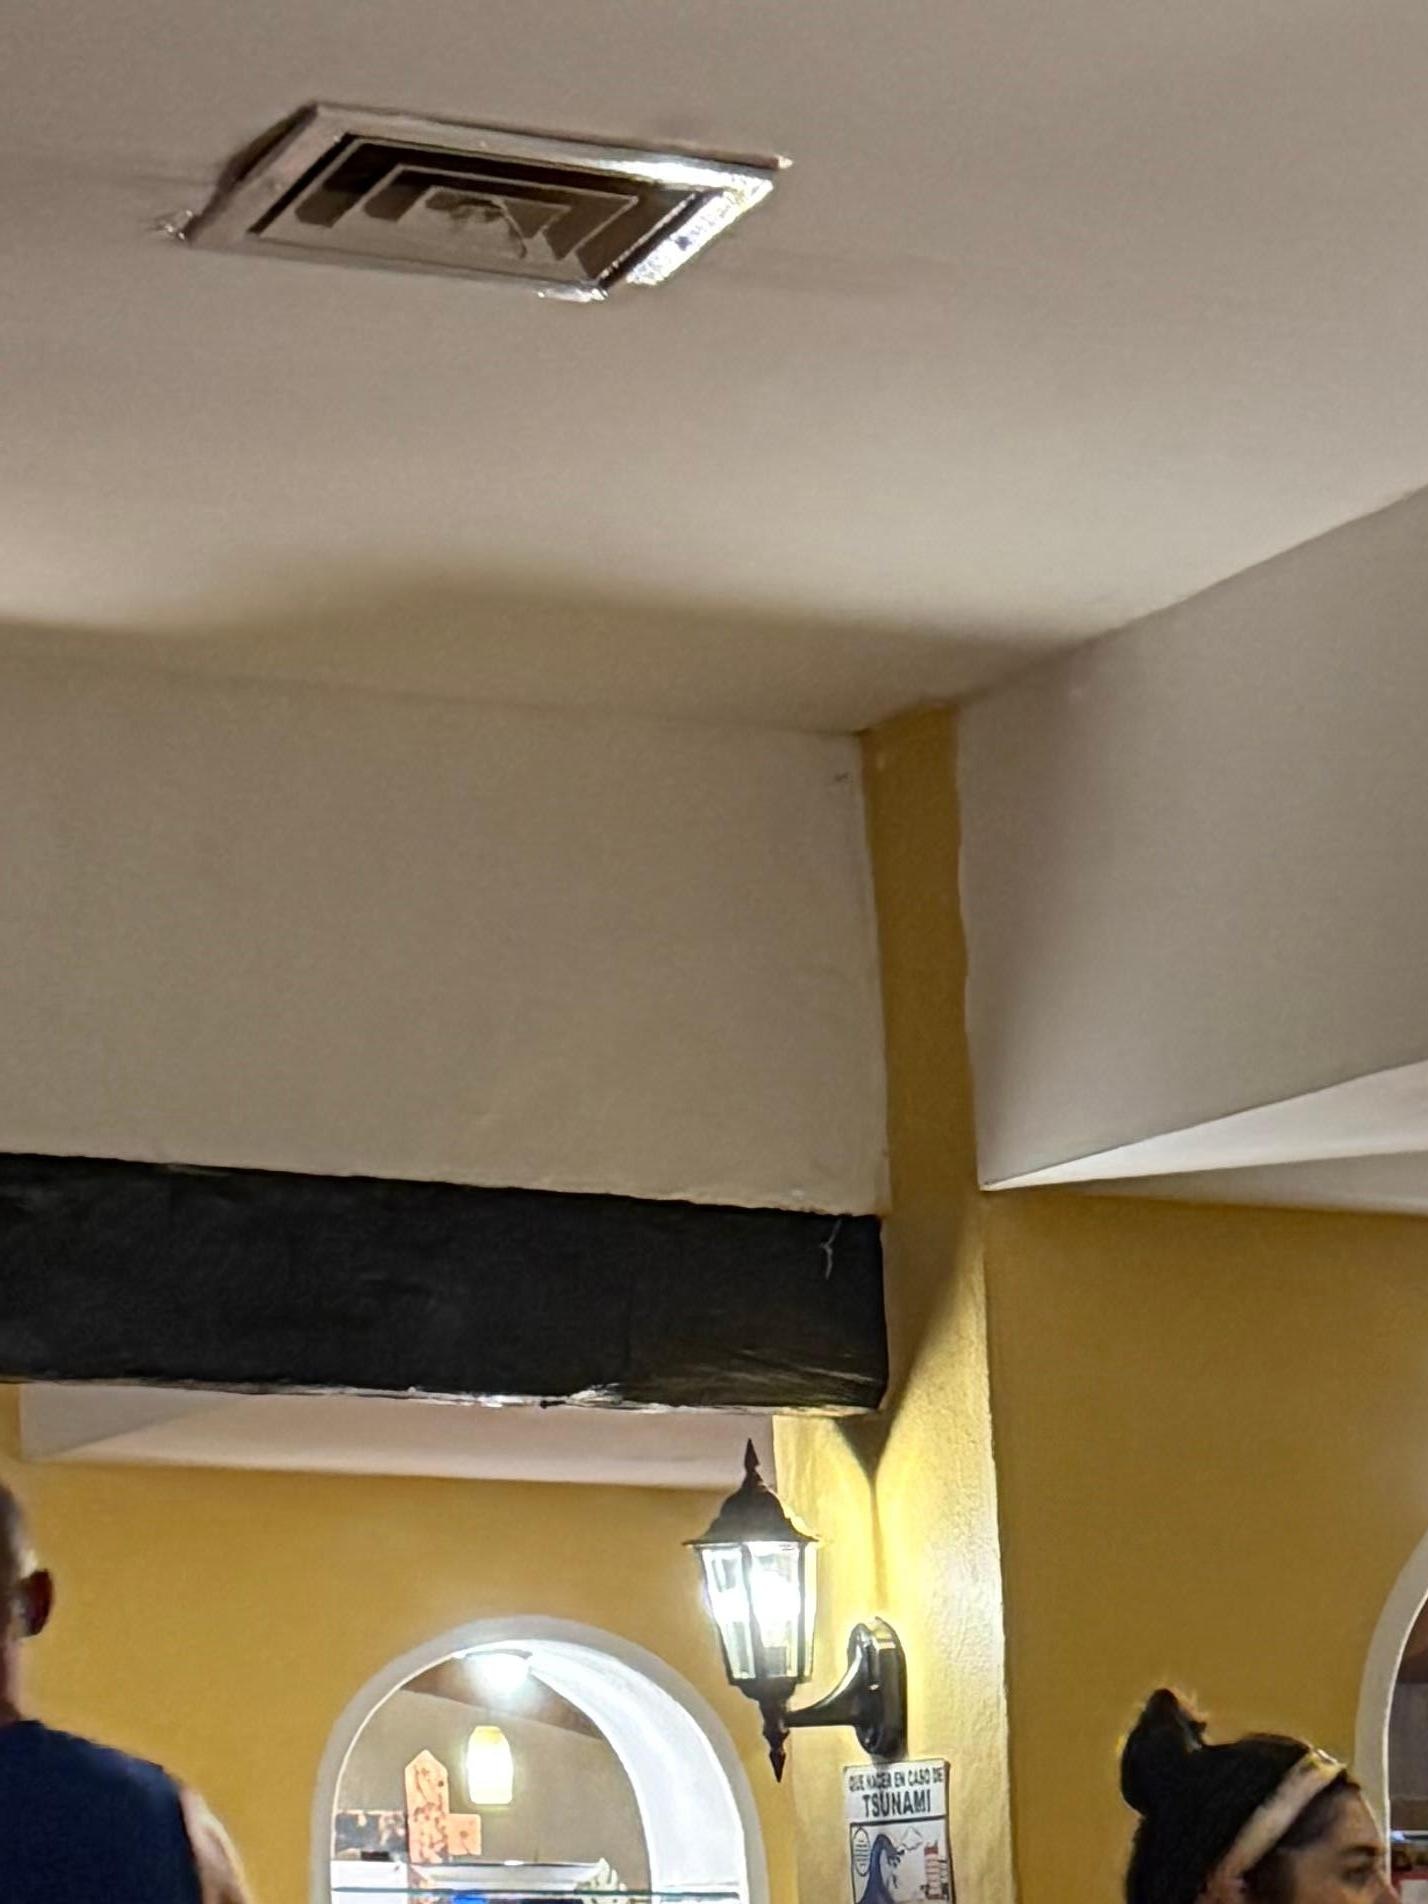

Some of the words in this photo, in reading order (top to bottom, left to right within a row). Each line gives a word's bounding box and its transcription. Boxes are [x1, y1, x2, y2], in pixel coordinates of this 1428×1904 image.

[894, 1771, 905, 1787] EN
[908, 1768, 930, 1786] CASO
[862, 1789, 931, 1818] TSUNAMI
